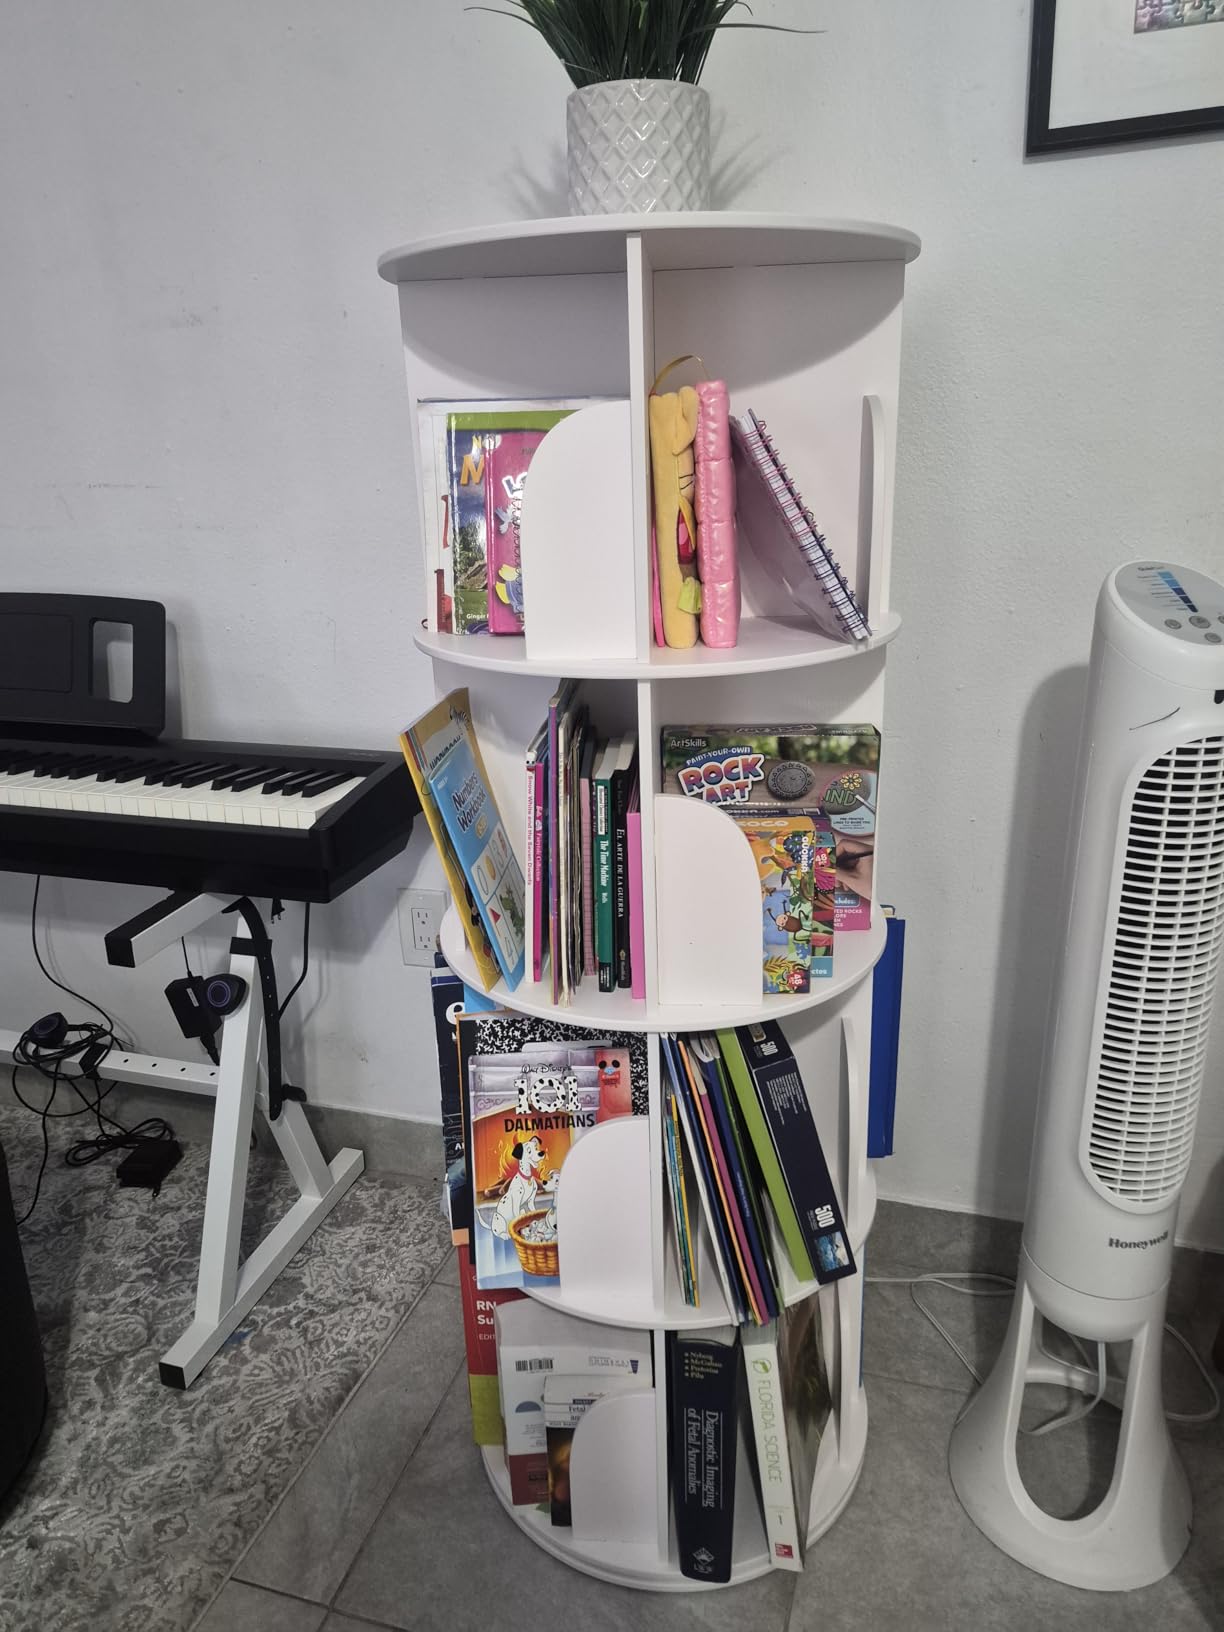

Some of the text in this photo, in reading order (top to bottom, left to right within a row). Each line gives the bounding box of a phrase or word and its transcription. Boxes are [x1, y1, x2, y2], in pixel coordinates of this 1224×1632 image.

[670, 738, 707, 748] ArtSkills
[680, 755, 764, 795] ROCK
[452, 772, 479, 811] Numbers
[704, 781, 750, 804] ART
[457, 787, 488, 833] Workbook
[600, 840, 609, 851] The
[801, 836, 809, 872] QUOKKA
[600, 851, 609, 864] Time
[816, 853, 827, 862] 48
[600, 865, 609, 887] Machine
[617, 864, 623, 875] DE
[617, 876, 624, 885] LA
[794, 973, 803, 985] 48
[760, 1041, 778, 1056] 500
[514, 1076, 582, 1115] 101
[504, 1113, 596, 1133] DALMATIANS
[815, 1204, 835, 1228] 500
[1108, 1230, 1169, 1250] Honeywell
[476, 1300, 497, 1311] RN
[757, 1379, 783, 1484] FLORIDA SCIENCE
[687, 1408, 700, 1495] of Fetal Anomalies
[702, 1410, 719, 1508] Diagnostic Imaging
